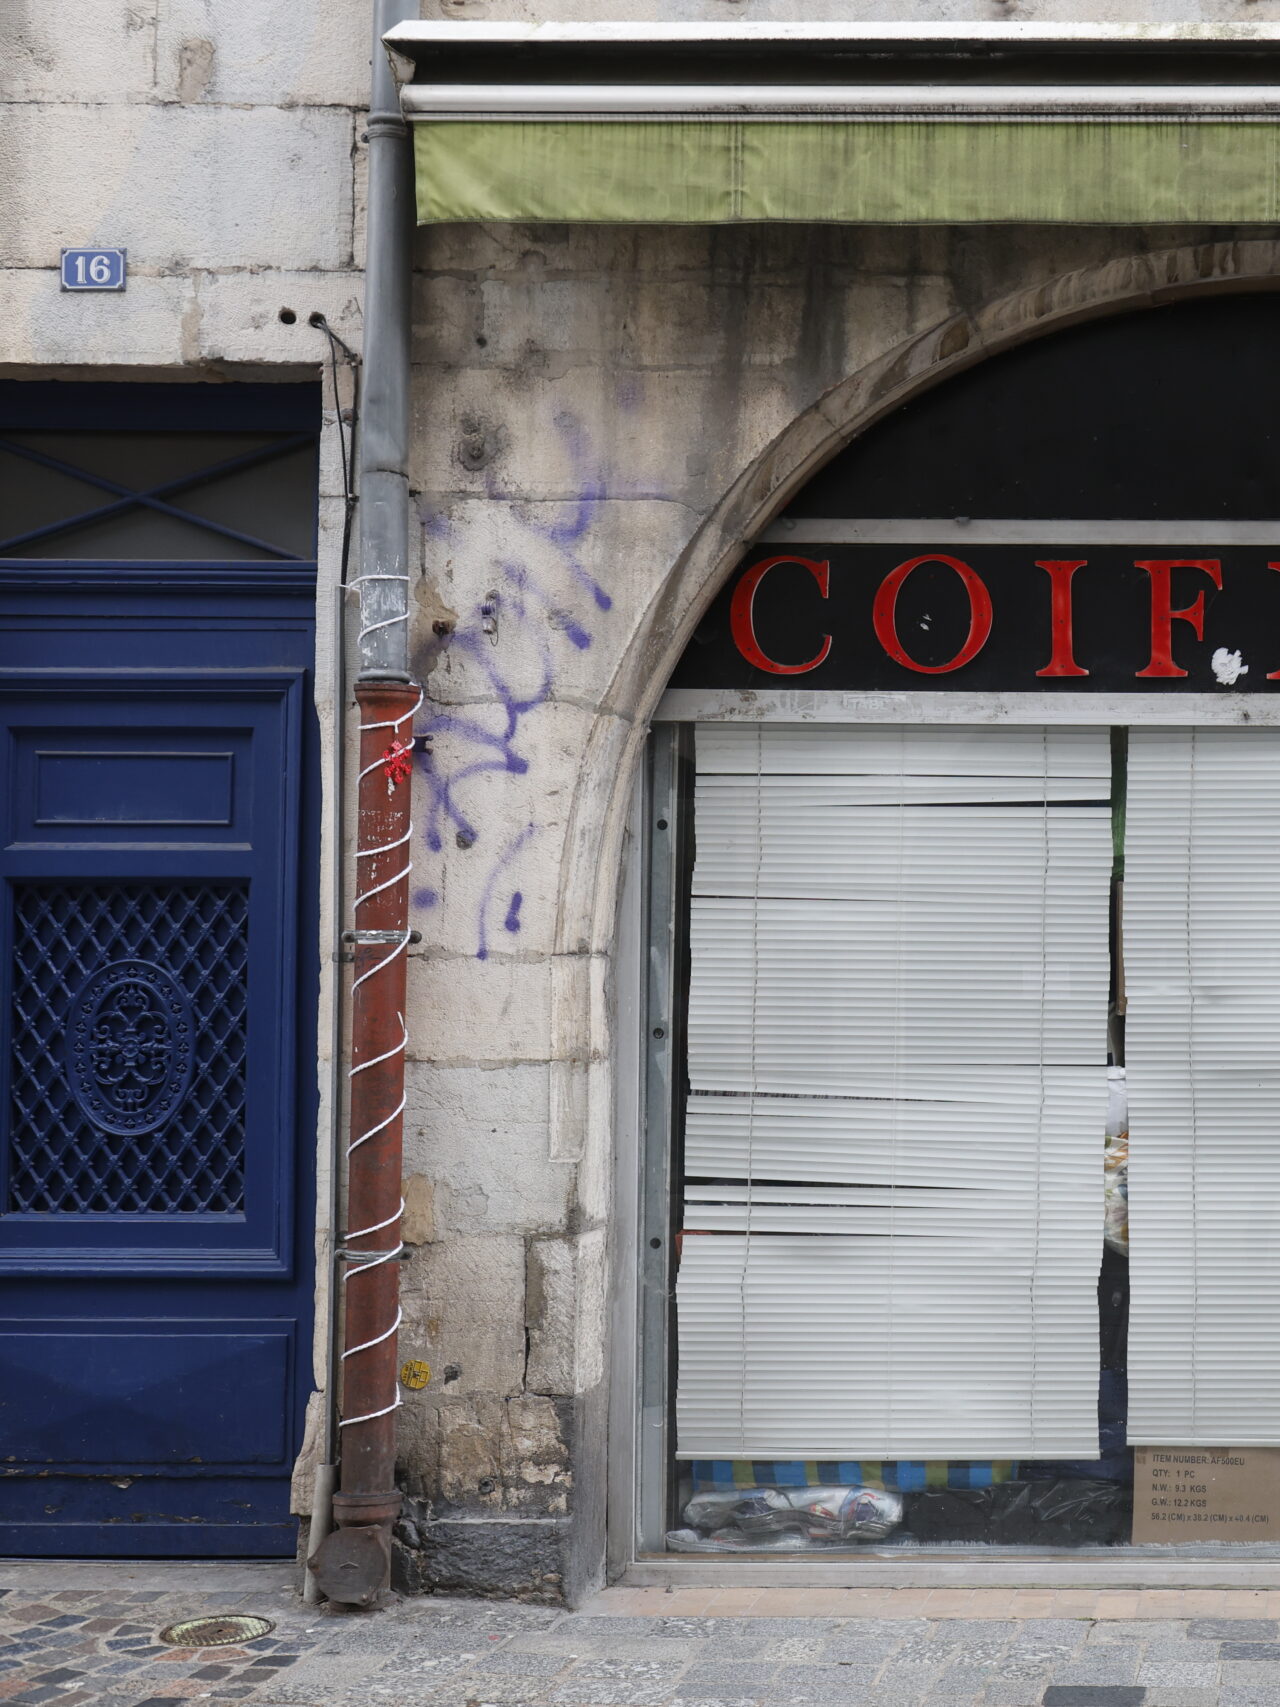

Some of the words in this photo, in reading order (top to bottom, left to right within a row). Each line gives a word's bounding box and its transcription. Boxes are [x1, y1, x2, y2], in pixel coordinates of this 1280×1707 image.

[75, 255, 111, 284] 16
[1152, 1454, 1172, 1463] ITEM
[1173, 1455, 1209, 1465] NUMBER:
[1152, 1468, 1170, 1478] QTY:
[1184, 1470, 1195, 1479] PC
[1175, 1485, 1186, 1493] 9.3
[1190, 1485, 1207, 1493] KGS
[1174, 1499, 1189, 1507] 12.2
[1190, 1499, 1207, 1508] KGS
[1168, 1512, 1185, 1523] (CM)
[1210, 1513, 1227, 1524] (CM)
[1251, 1513, 1269, 1524] (CM)
